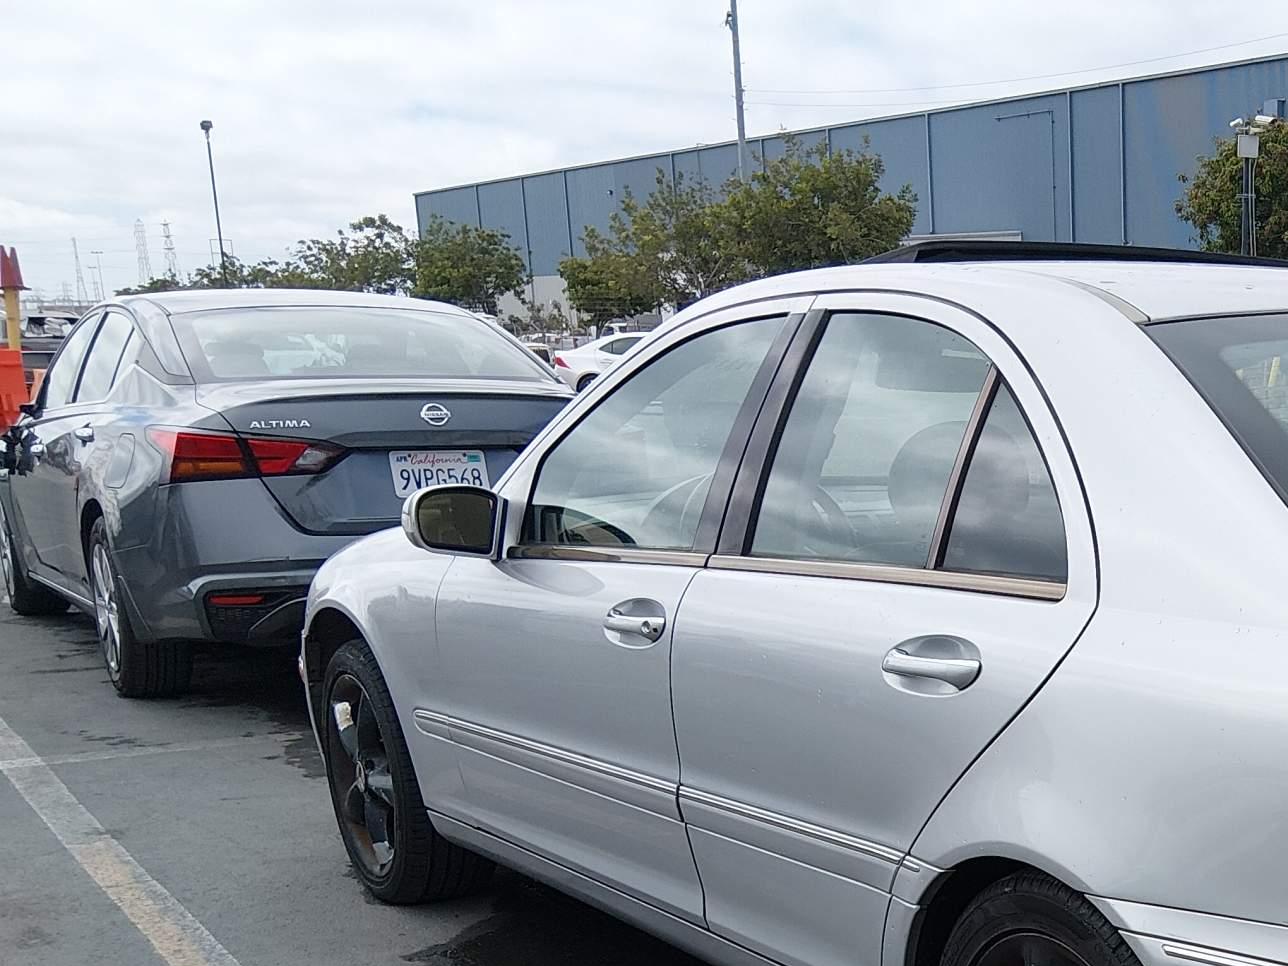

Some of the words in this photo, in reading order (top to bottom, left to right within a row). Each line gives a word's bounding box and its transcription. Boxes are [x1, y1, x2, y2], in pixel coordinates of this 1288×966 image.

[249, 419, 312, 429] ALTIMA
[410, 453, 467, 468] California
[400, 467, 483, 491] 9VPG568
